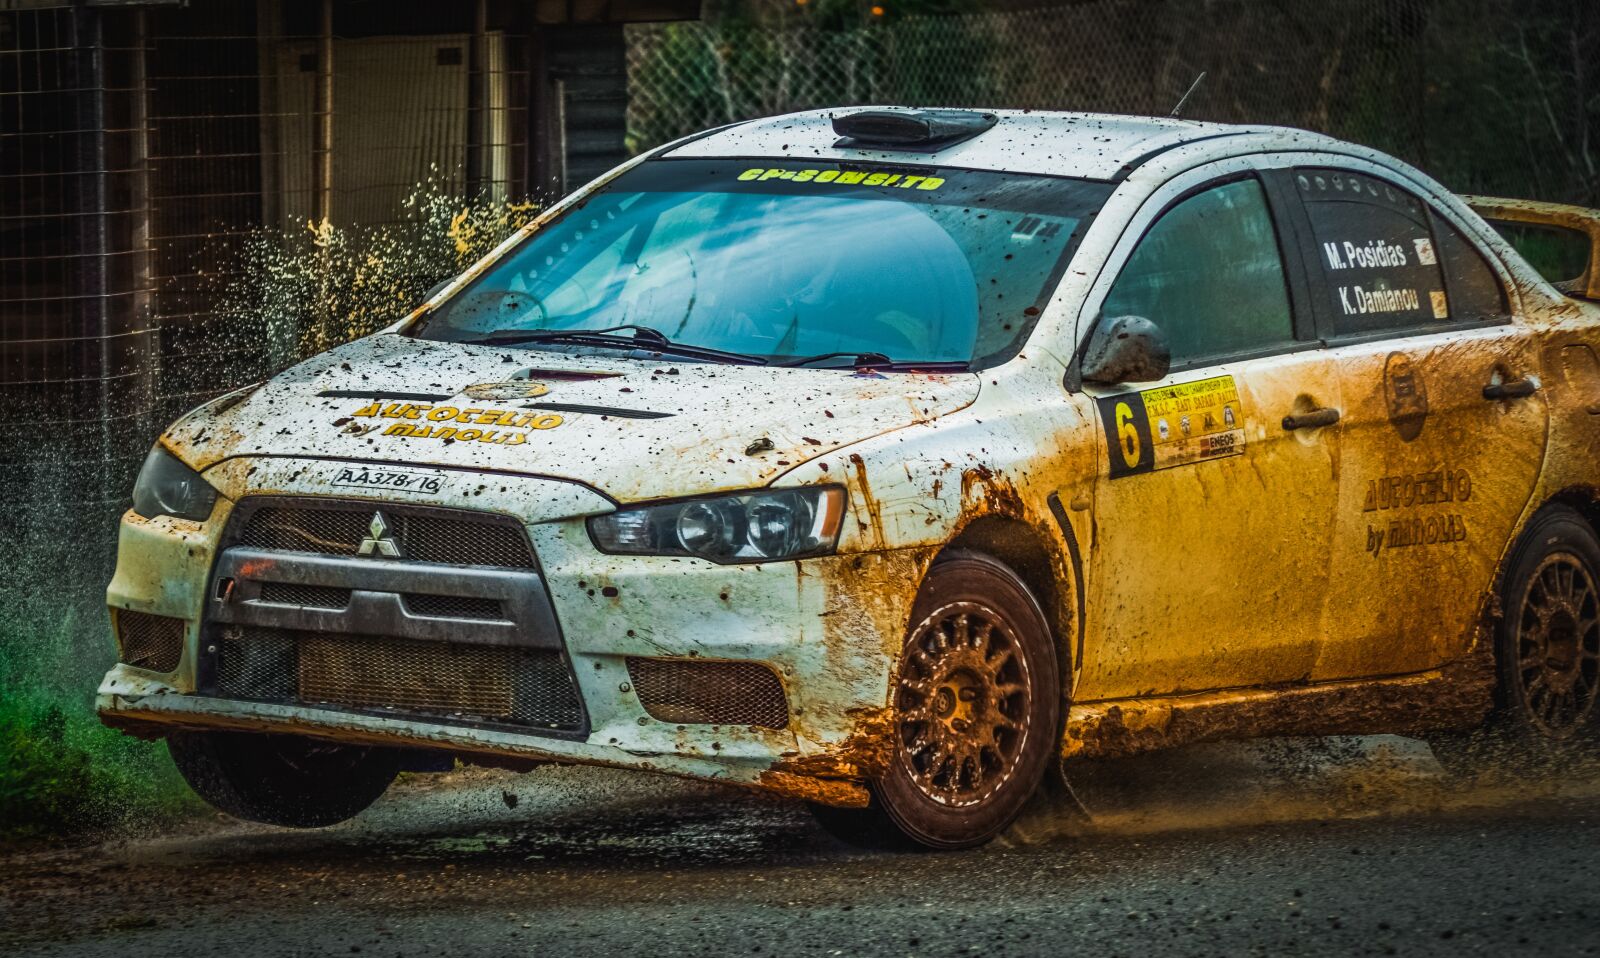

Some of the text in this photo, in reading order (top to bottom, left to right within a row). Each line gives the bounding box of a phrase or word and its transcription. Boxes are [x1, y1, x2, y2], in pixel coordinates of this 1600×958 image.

[1344, 239, 1407, 268] Posidias
[1339, 284, 1420, 315] K. Damianou
[1115, 402, 1141, 468] 6
[1209, 433, 1234, 448] ENEOS
[1365, 524, 1385, 559] by
